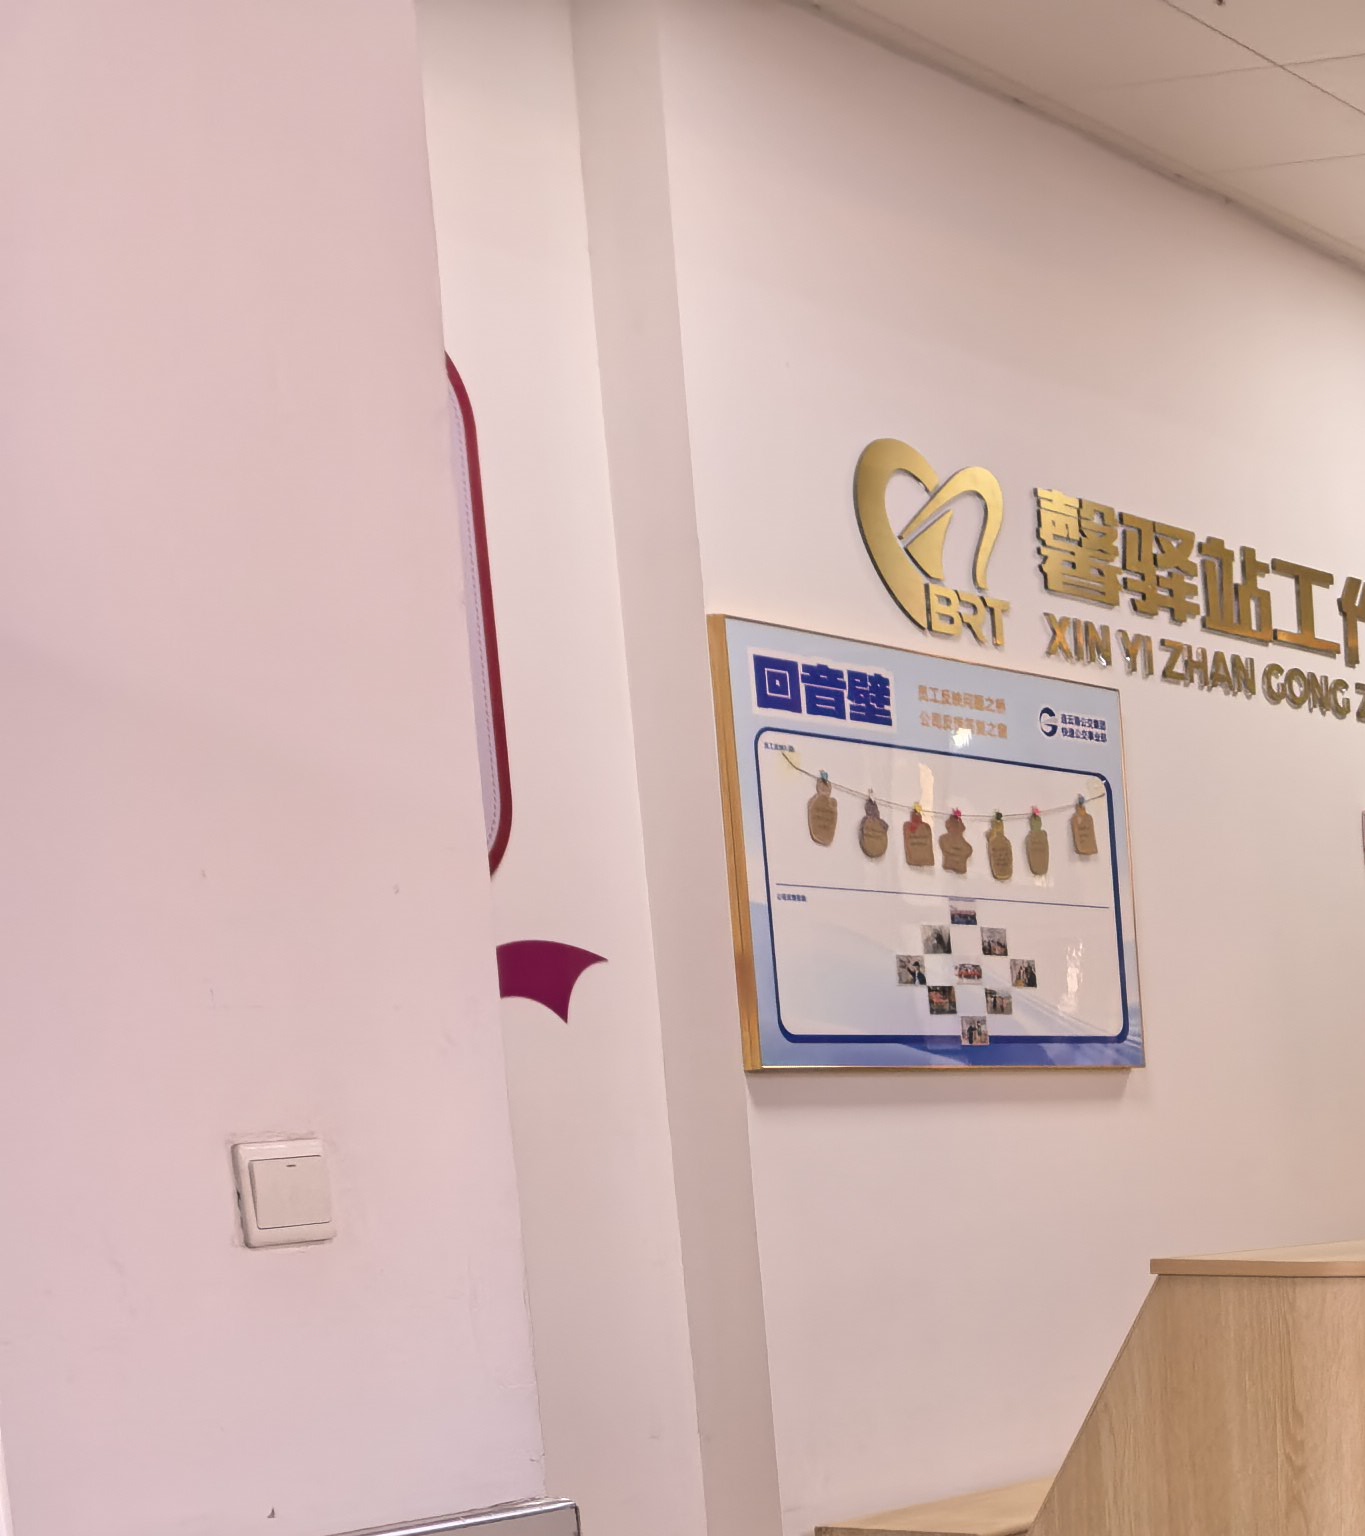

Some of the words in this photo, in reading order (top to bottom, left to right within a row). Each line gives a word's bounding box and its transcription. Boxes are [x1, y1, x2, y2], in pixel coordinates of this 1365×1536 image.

[924, 582, 1009, 650] BRT
[753, 654, 893, 726] 回音壁
[1043, 612, 1112, 668] XIN
[1115, 629, 1154, 678] YI
[1159, 638, 1256, 700] ZHAN
[1262, 662, 1351, 720] GONG
